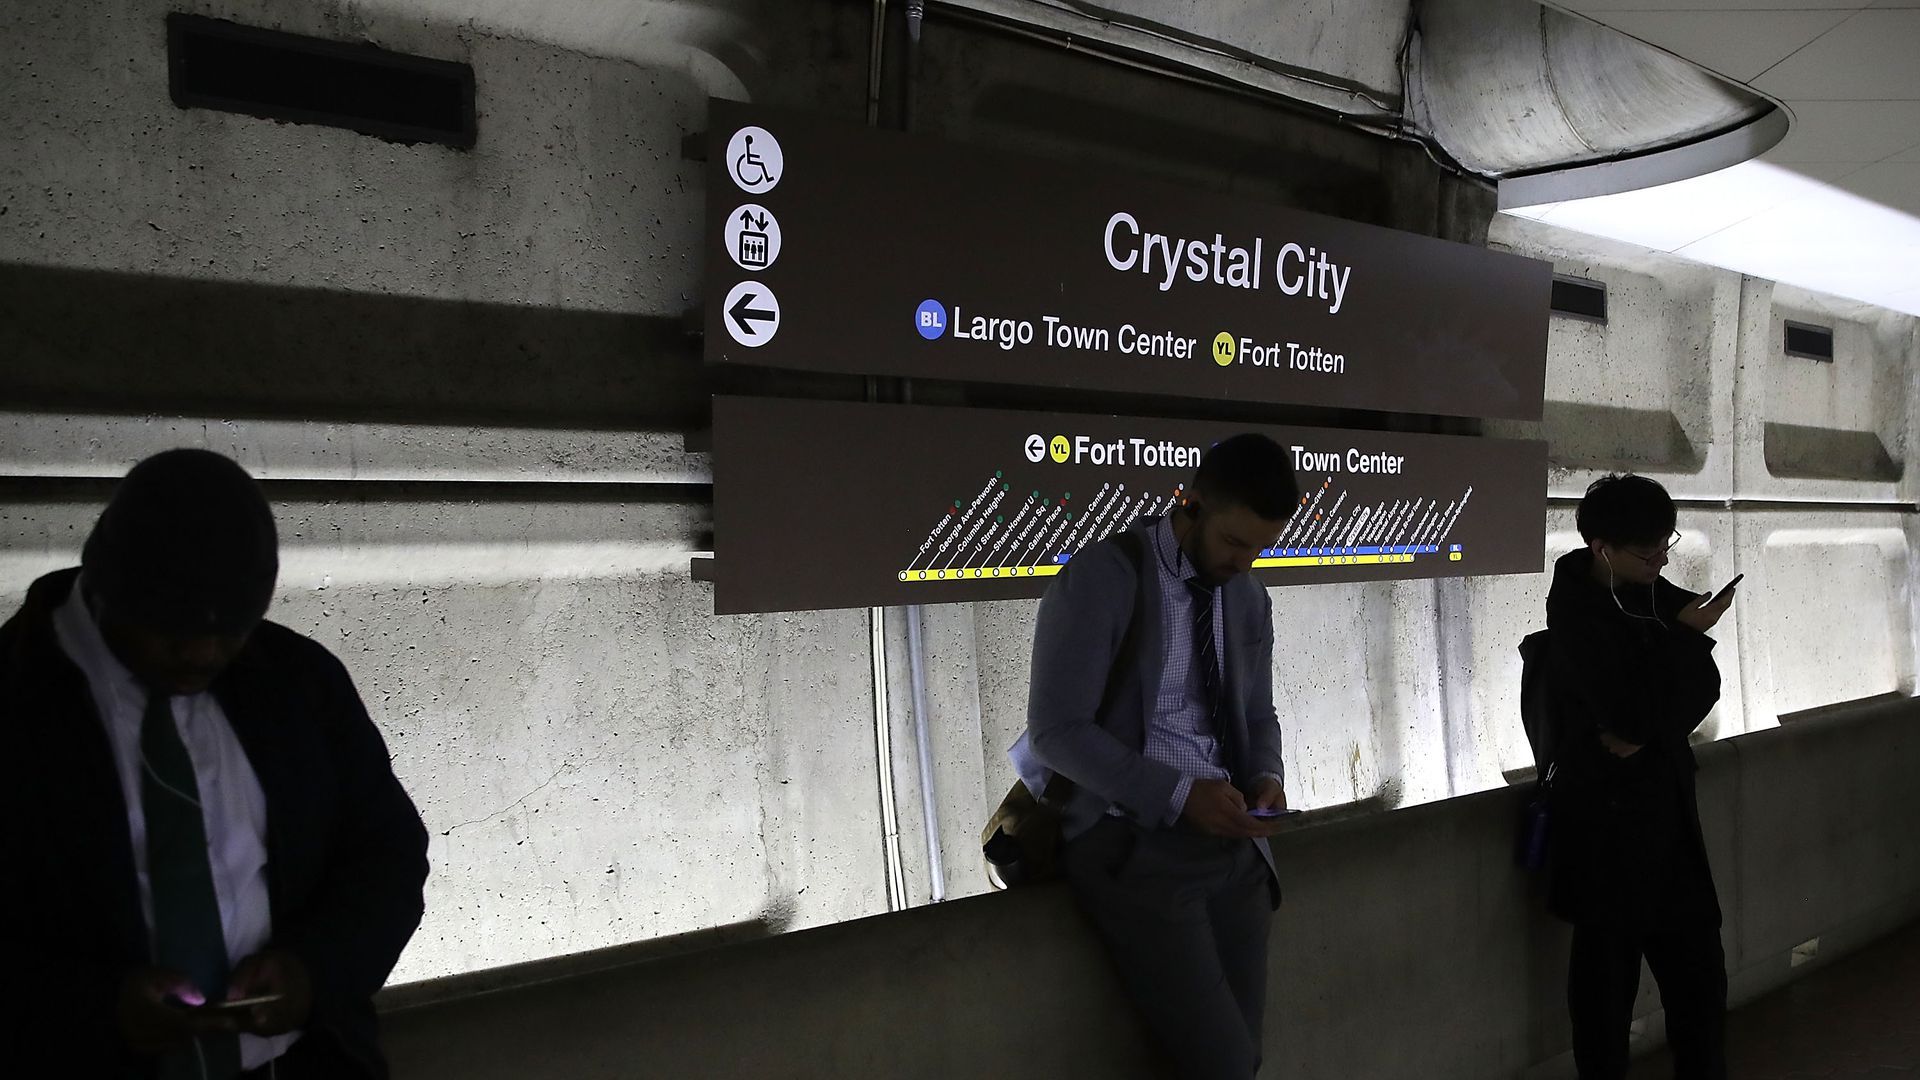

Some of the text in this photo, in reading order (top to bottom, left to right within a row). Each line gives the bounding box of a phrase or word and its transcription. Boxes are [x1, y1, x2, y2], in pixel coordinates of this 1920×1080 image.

[1104, 211, 1352, 314] Crystal City
[920, 311, 942, 329] BL
[953, 306, 1197, 360] Largo Town Center
[1215, 340, 1232, 356] YL
[1238, 337, 1346, 374] Fort Totten
[1053, 444, 1067, 456] YL
[1075, 436, 1201, 468] Fort Totten
[1291, 446, 1404, 475] Town Center
[939, 477, 998, 553] Georgia Ave-Petworth
[957, 490, 1005, 553] Columbia Heights
[993, 496, 1035, 552] Shaw-Howard U
[1010, 505, 1046, 552] Mt Vernon Sq
[1028, 505, 1062, 551] Gallery Place
[1061, 488, 1106, 550] Largo Town Center
[1077, 488, 1120, 549] Morgan Boulevard
[1112, 501, 1127, 522] Road
[1125, 499, 1144, 526] Heights
[1288, 486, 1325, 545] Foggy Bottom-GWU
[1336, 503, 1362, 544] Pentagon City
[920, 514, 952, 554] Fort Totten
[975, 521, 999, 552] U Street
[1045, 519, 1068, 551] Archives
[1313, 516, 1331, 545] Arlington
[1324, 516, 1343, 545] Pentagon
[1348, 521, 1362, 543] Crystal
